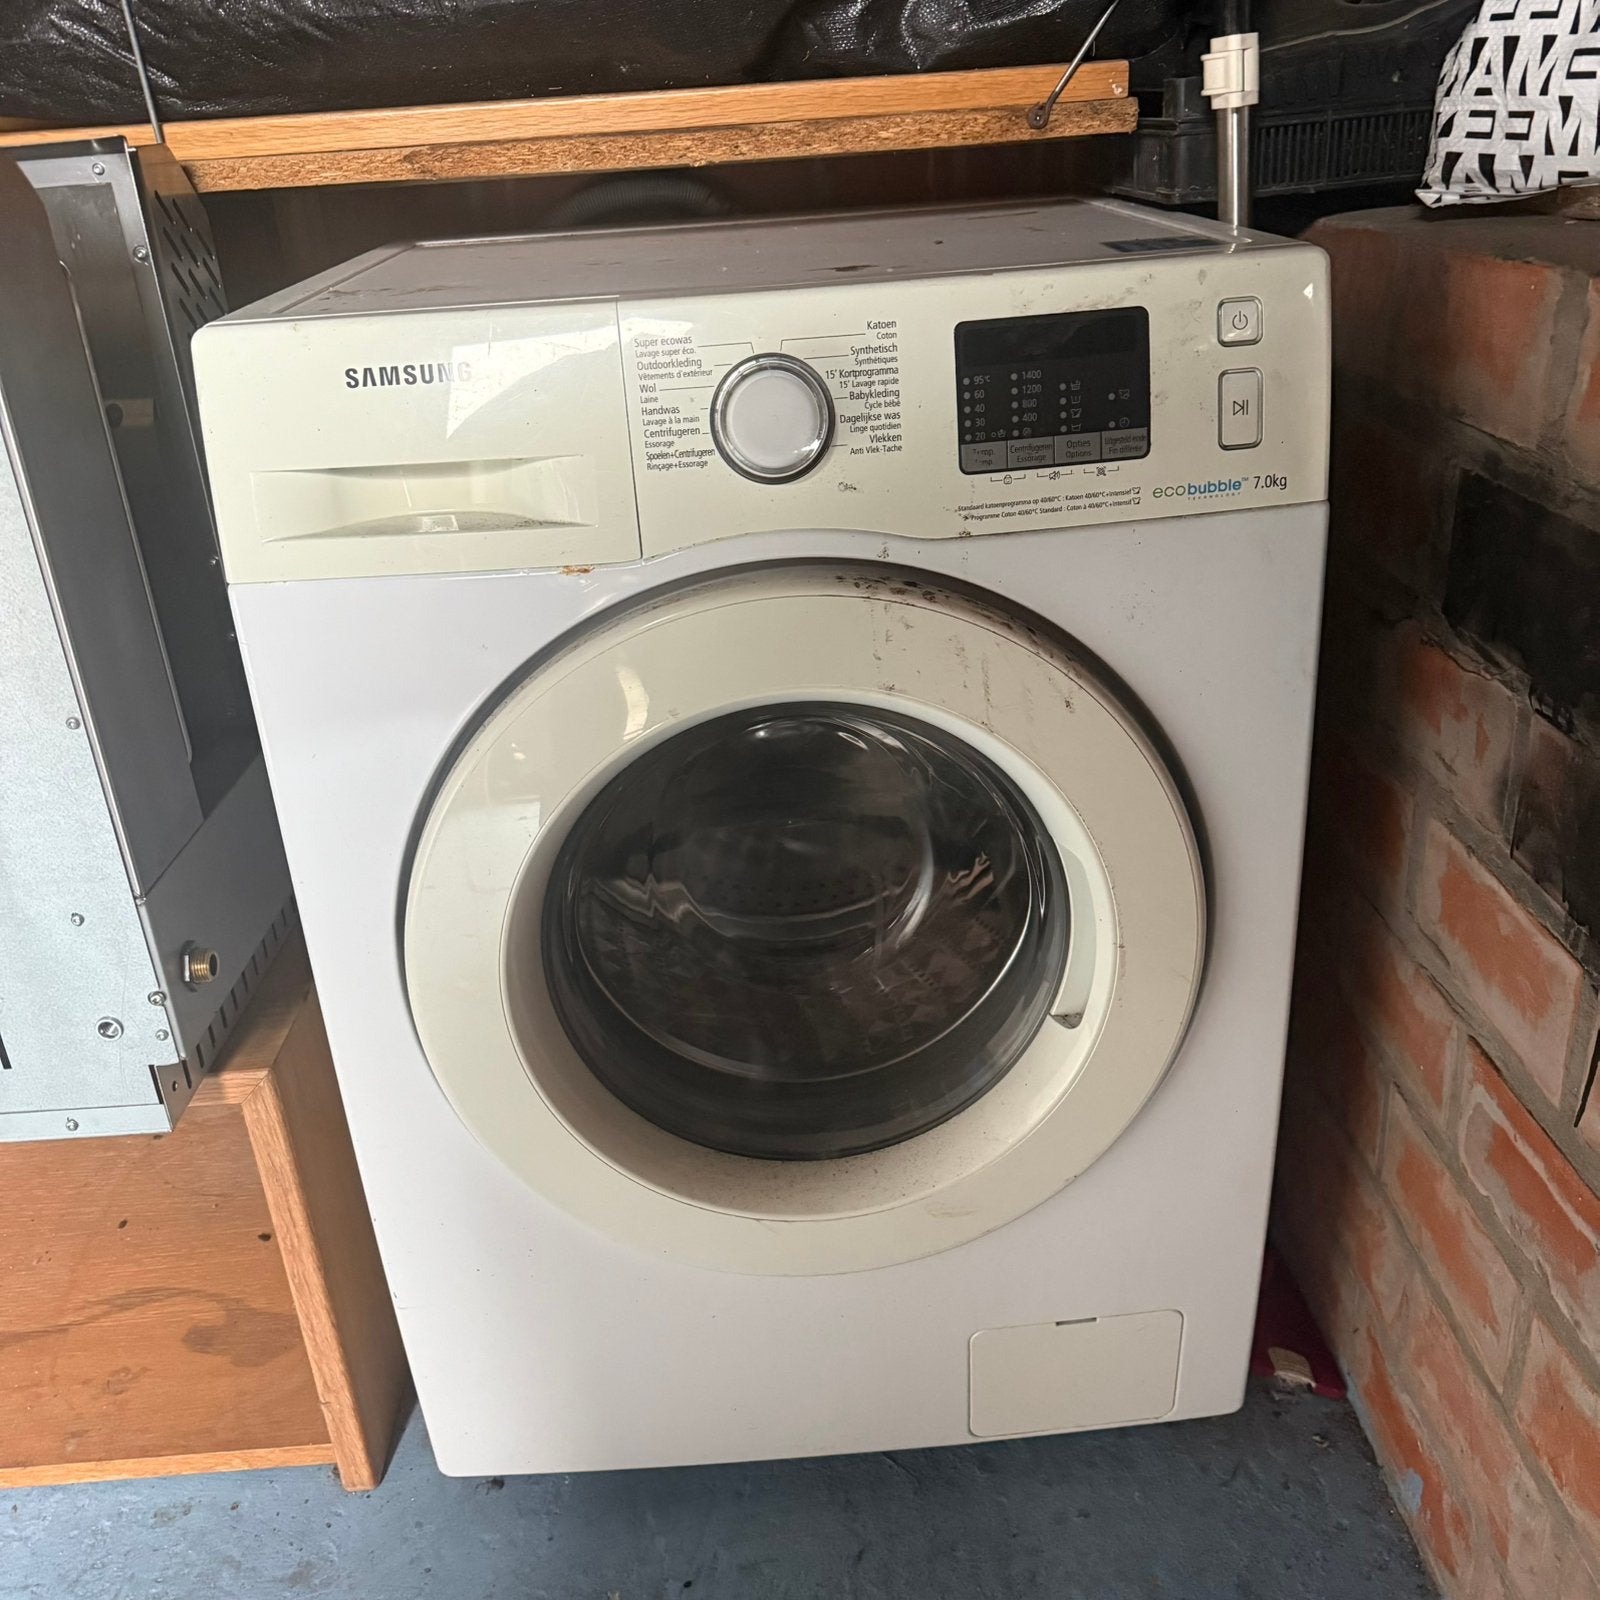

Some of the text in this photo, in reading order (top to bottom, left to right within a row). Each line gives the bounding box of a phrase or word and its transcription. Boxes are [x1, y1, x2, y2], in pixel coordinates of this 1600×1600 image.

[866, 320, 896, 330] Katoen
[634, 335, 692, 348] Super ecowas
[876, 332, 898, 340] Coton
[635, 346, 696, 359] Lavage super éco.
[850, 342, 898, 357] Synthetisch
[636, 358, 702, 370] Outdoorkleding
[855, 356, 898, 366] Synthétiques
[345, 362, 472, 388] SAMSUNG
[638, 372, 675, 381] Vêtements
[839, 366, 899, 380] Kortprogramma
[1022, 370, 1042, 380] 1400
[852, 378, 876, 388] Lavage
[878, 377, 900, 387] rapide
[639, 384, 656, 393] Wol
[1022, 384, 1042, 394] 1200
[640, 395, 658, 404] Laine
[850, 388, 900, 401] Babykleding
[974, 390, 984, 399] 60
[864, 400, 882, 411] Cycle
[974, 404, 985, 413] 40
[1022, 399, 1038, 408] 800
[642, 406, 680, 416] Handwas
[642, 415, 700, 427] Lavage à la main
[840, 412, 901, 425] Dagelijkse was
[975, 418, 986, 427] 30
[1022, 413, 1038, 422] 400
[644, 426, 700, 438] Centrifugeren
[850, 422, 901, 434] Linge quotidien
[869, 432, 902, 443] Vlekken
[976, 432, 986, 441] 20
[644, 440, 675, 448] Essorage
[850, 444, 902, 455] Anti Vlek-Tache
[1066, 440, 1091, 448] Opties
[1066, 450, 1092, 458] Options
[647, 460, 708, 471] Rinçage+Essorage
[1253, 474, 1287, 490] 7.0kg
[958, 503, 984, 512] Standaard
[985, 500, 1032, 508] katoenprogramma
[970, 512, 1000, 522] Programme
[1040, 506, 1062, 514] Standard
[1066, 504, 1082, 512] Coton
